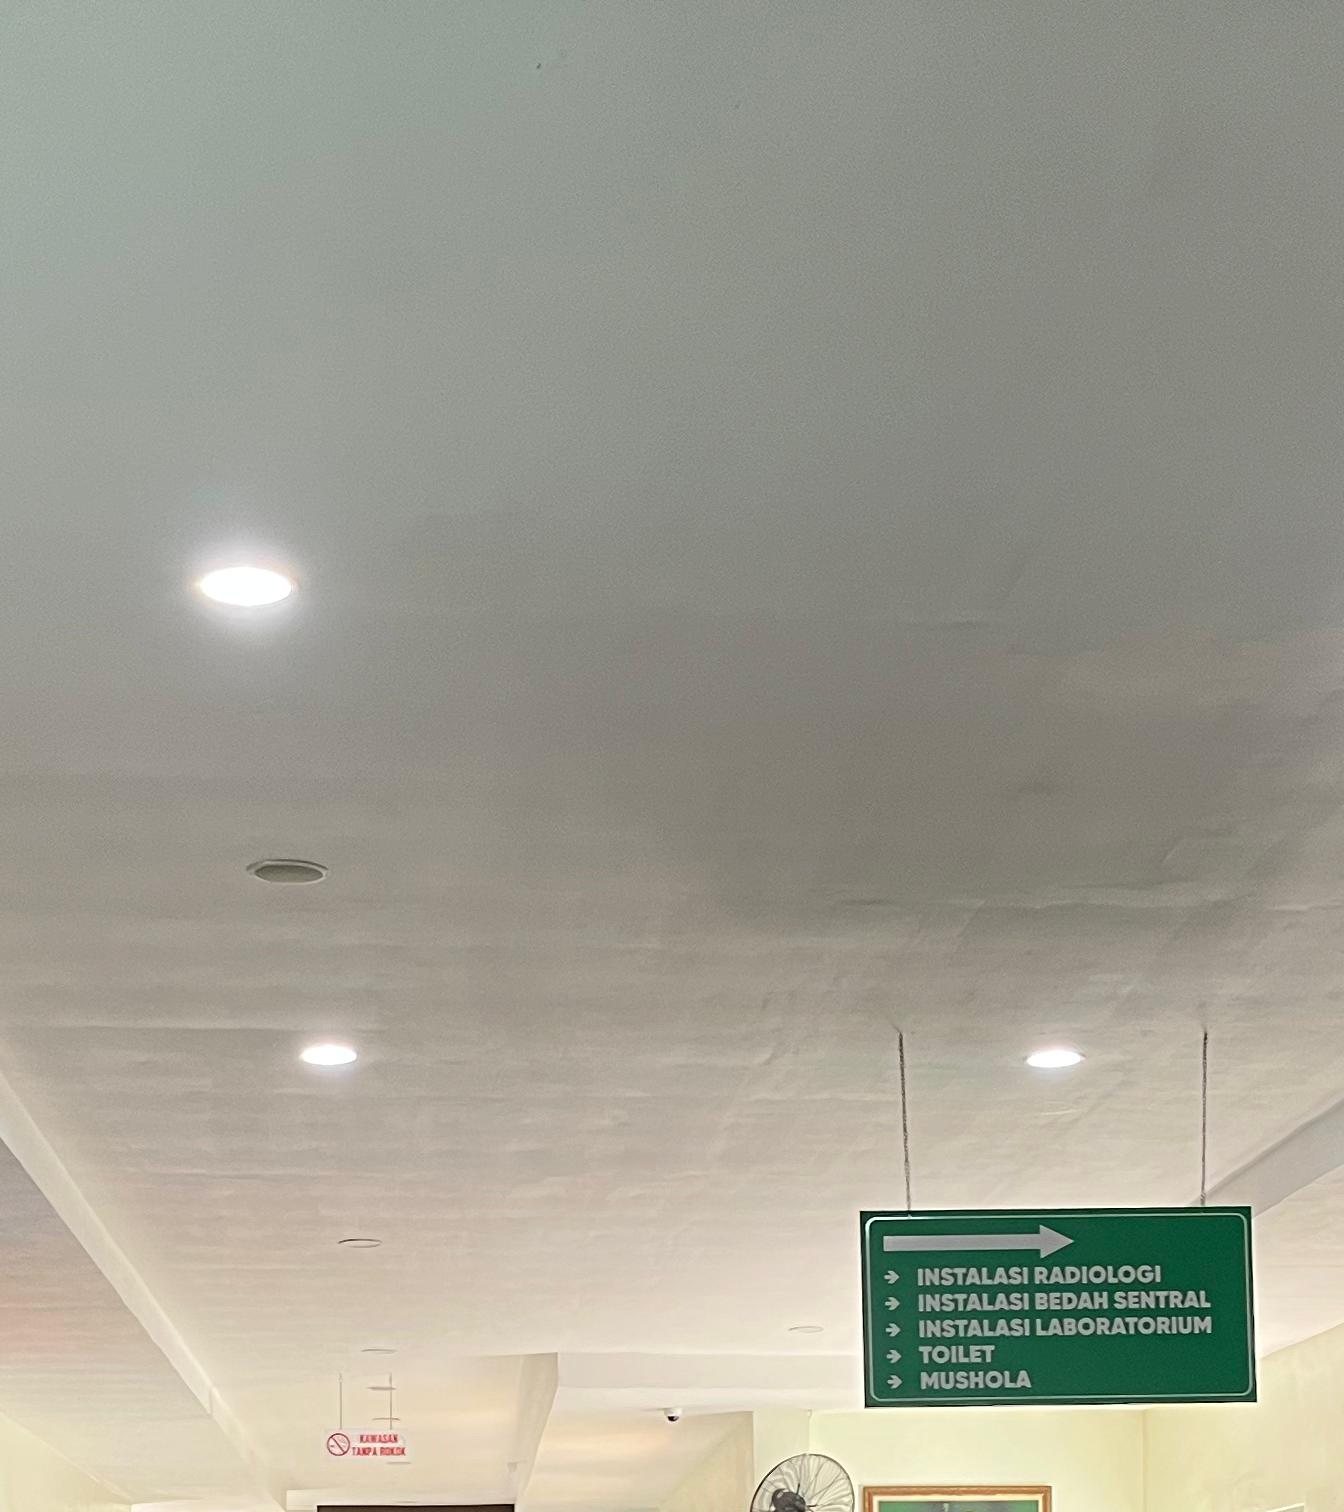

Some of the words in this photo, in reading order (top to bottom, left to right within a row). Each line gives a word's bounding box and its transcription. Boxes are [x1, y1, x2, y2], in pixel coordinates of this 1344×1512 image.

[917, 1267, 1029, 1286] INSTALASI
[1034, 1265, 1161, 1285] RADIOLOGI
[918, 1293, 1030, 1312] INSTALASI
[1035, 1291, 1109, 1310] BEDAH
[1113, 1290, 1211, 1309] SENTRAL
[919, 1319, 1031, 1338] INSTALASI
[1035, 1316, 1212, 1336] LABORATORIUM
[919, 1345, 995, 1364] TOILET
[920, 1370, 1031, 1390] MUSHOLA
[359, 1434, 398, 1443] KAWASAN
[352, 1447, 377, 1456] TANPA
[379, 1447, 406, 1456] ROKOK
